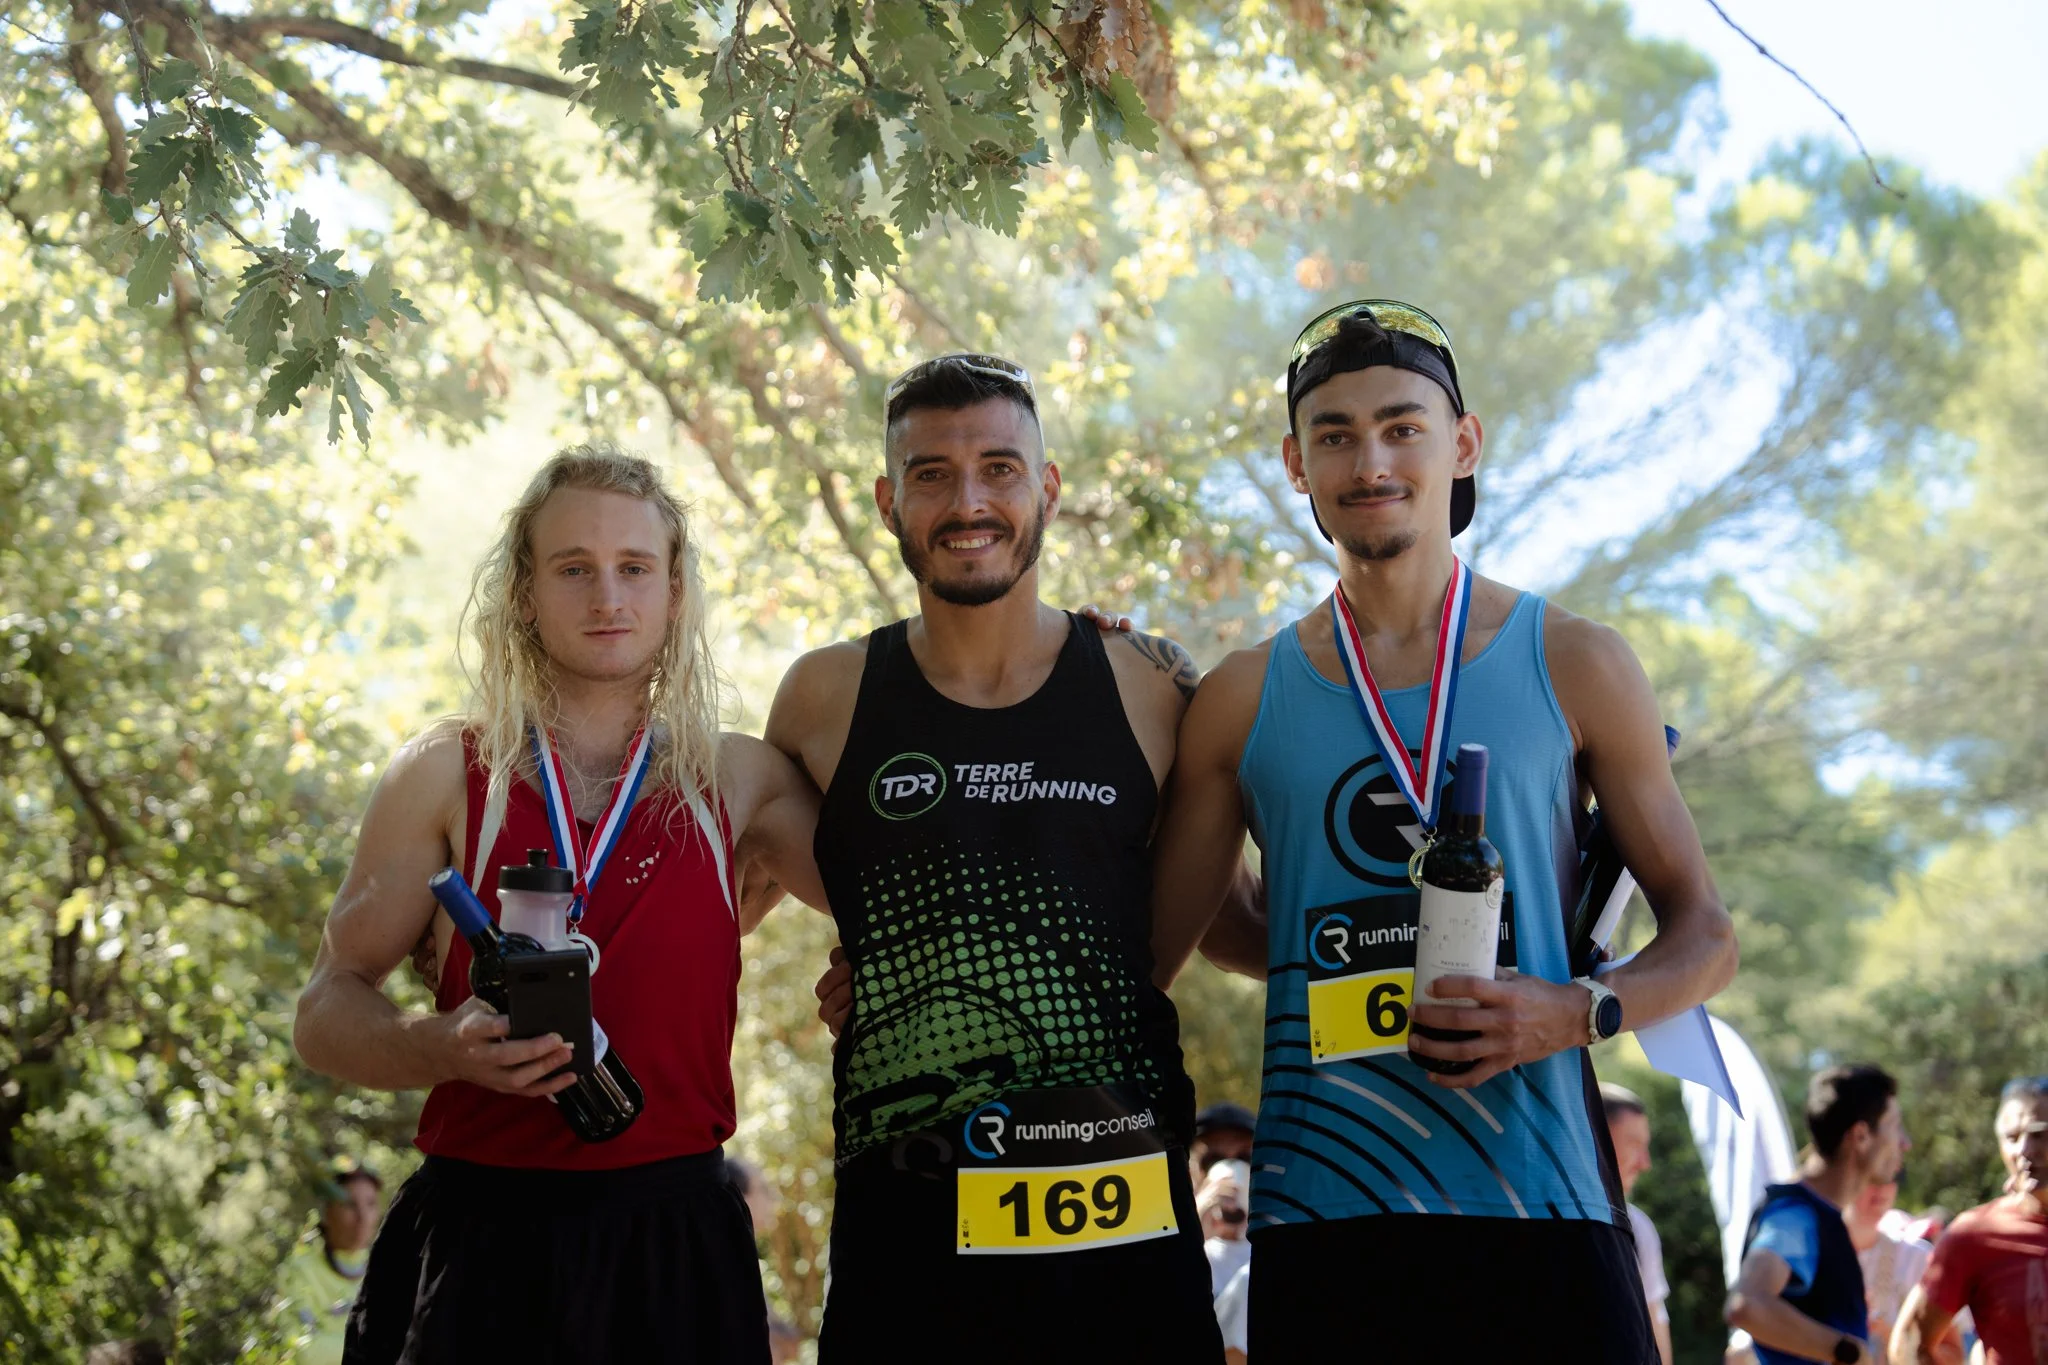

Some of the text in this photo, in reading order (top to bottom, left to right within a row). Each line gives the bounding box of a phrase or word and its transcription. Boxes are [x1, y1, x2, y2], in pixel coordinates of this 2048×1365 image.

[954, 761, 1035, 783] TERRE
[881, 773, 937, 801] TDR
[965, 780, 1117, 805] DE RUNNING
[1015, 1108, 1155, 1142] runningconseil
[999, 1174, 1132, 1237] 169
